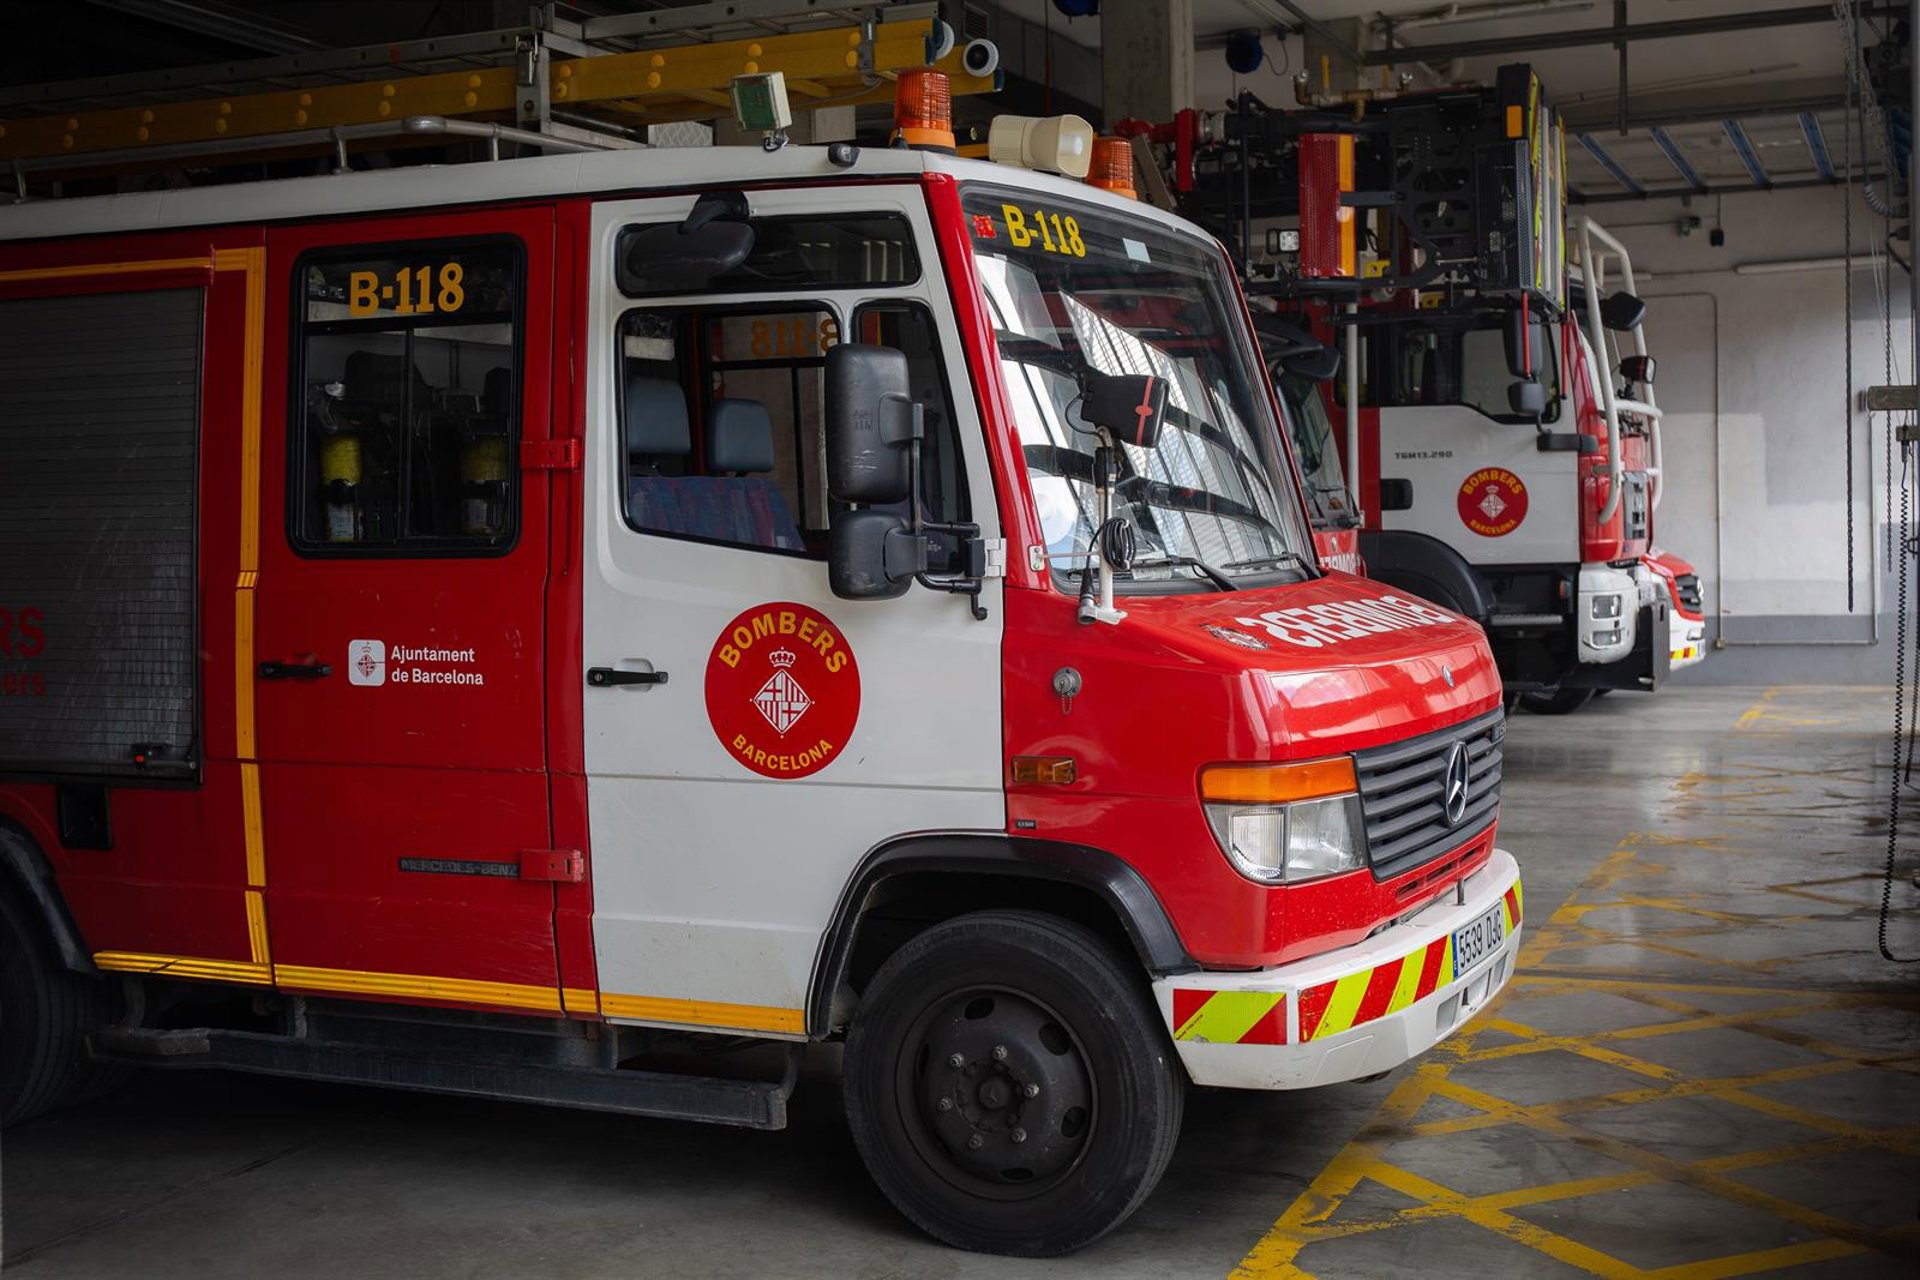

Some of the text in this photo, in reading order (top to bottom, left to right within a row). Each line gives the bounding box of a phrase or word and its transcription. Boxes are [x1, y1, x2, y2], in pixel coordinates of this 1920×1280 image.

[1001, 204, 1086, 258] B-118
[1463, 469, 1523, 495] BOMBERS
[1470, 518, 1517, 535] BARCELONA
[391, 645, 475, 664] Ajuntament
[718, 611, 848, 673] BOMBERS
[391, 667, 484, 685] de Barcelona
[732, 734, 833, 771] BARCELONA
[400, 859, 518, 877] MERCEDES-BENZ
[1458, 922, 1483, 968] 5539
